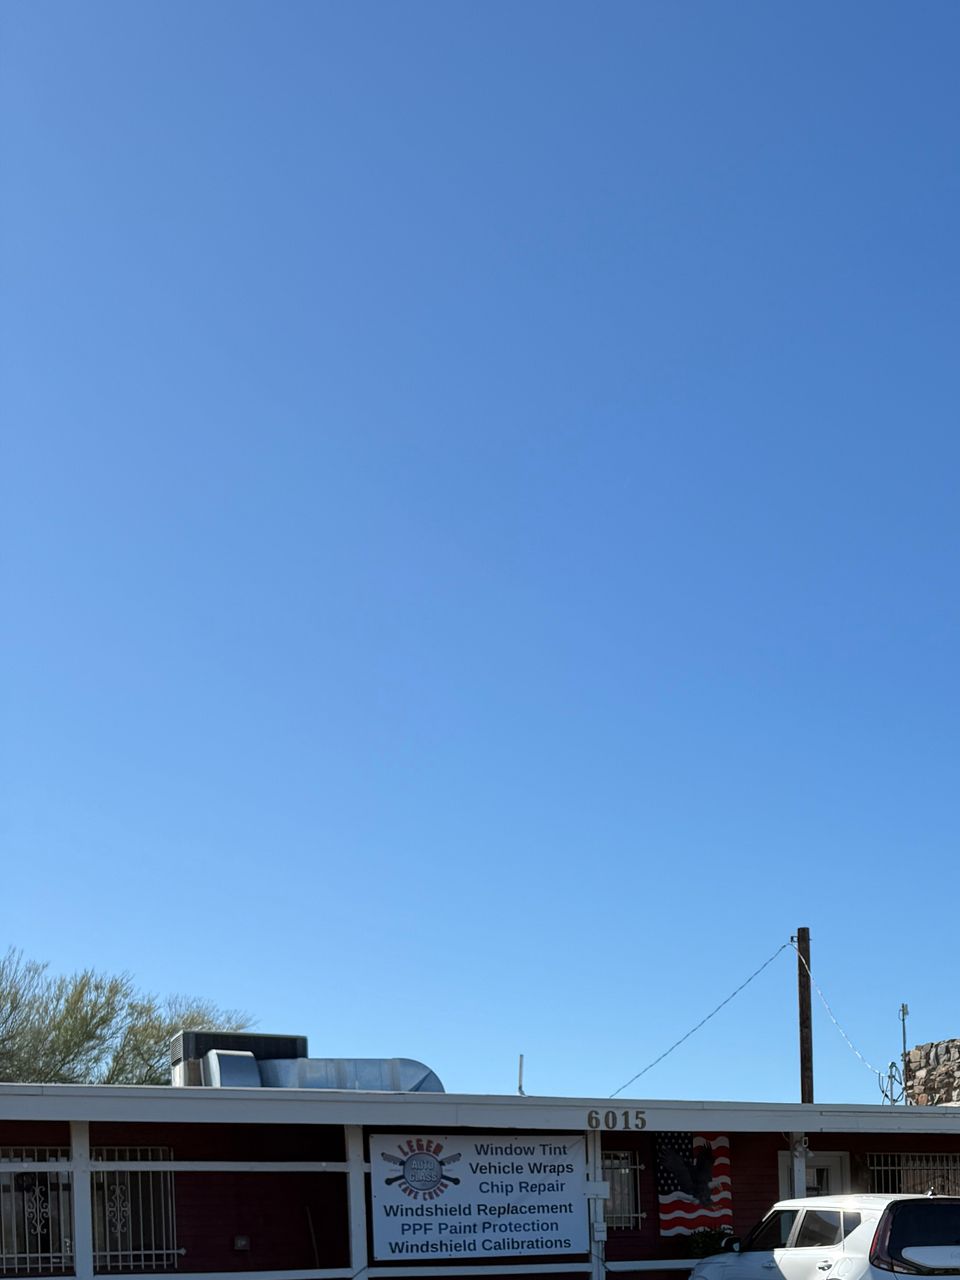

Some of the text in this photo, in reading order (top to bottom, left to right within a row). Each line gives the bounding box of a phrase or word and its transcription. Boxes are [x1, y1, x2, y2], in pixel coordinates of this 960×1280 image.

[588, 1110, 646, 1129] 6015
[474, 1143, 567, 1156] Window Tint
[411, 1160, 434, 1170] AUTO
[469, 1162, 573, 1177] Vehicle Wraps
[409, 1171, 437, 1182] GLASS
[479, 1180, 565, 1197] Chip Repair
[383, 1202, 573, 1218] Windshield Replacement
[401, 1219, 559, 1235] PPF Paint Protection
[389, 1237, 571, 1254] Windshield Calibrations
